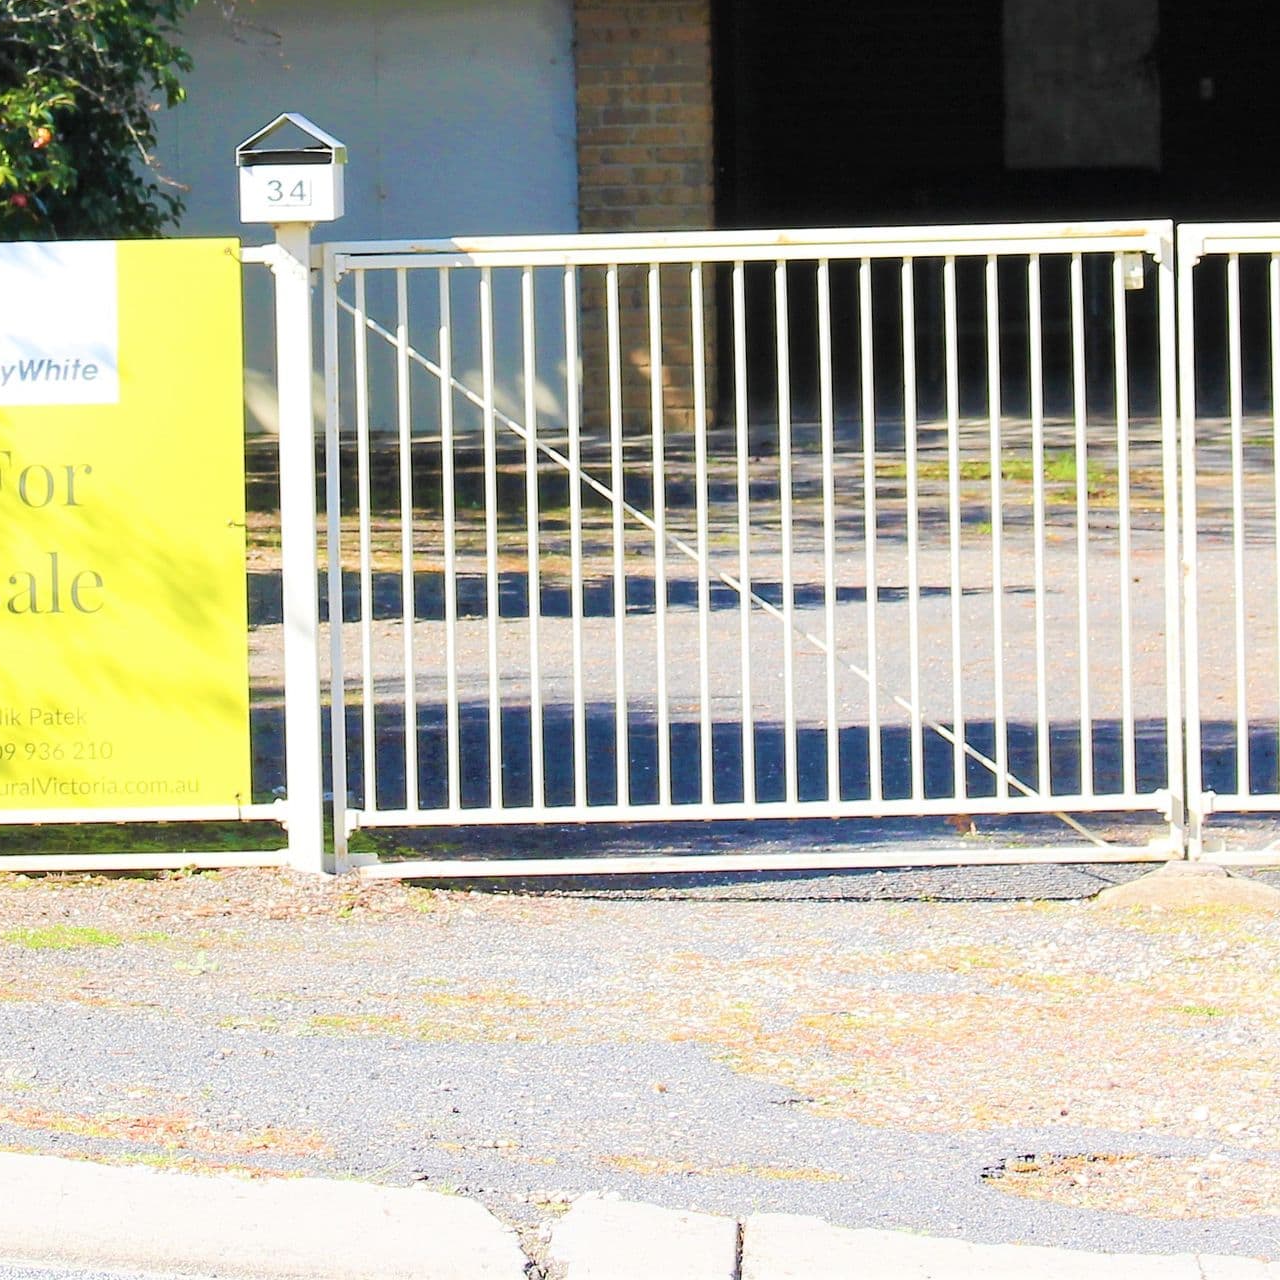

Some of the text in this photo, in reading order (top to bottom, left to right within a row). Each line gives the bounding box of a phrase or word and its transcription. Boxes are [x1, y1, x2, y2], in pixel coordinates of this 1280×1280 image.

[266, 179, 307, 202] 34
[29, 706, 88, 726] Patek
[24, 742, 66, 761] 936
[72, 741, 114, 760] 210
